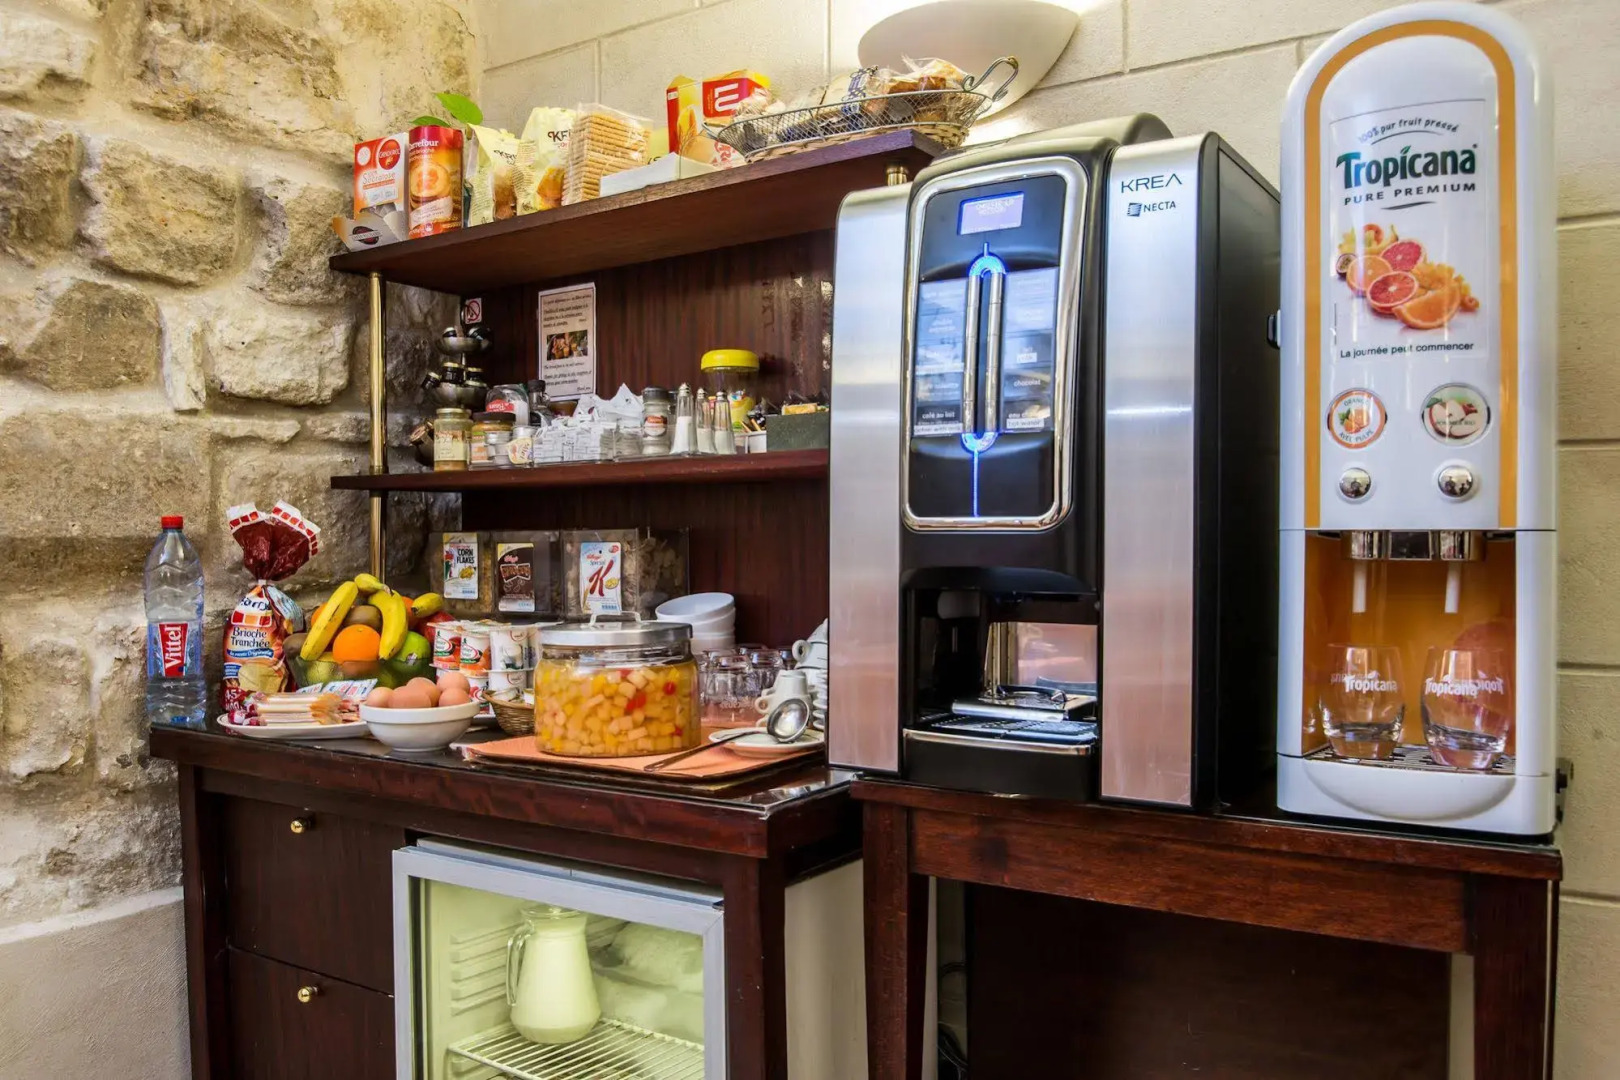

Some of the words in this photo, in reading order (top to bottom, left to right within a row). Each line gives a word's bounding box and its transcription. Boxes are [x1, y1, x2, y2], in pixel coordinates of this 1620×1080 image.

[1380, 122, 1396, 134] pur
[1398, 117, 1422, 127] fruit
[409, 138, 439, 149] arrefour
[1335, 146, 1476, 189] Tropicana
[1121, 173, 1182, 193] KREA
[1344, 191, 1384, 205] PURE
[1394, 183, 1476, 198] PREMIUM
[1143, 201, 1176, 212] NECTA
[1340, 350, 1351, 358] La
[1353, 346, 1388, 358] journée
[1416, 343, 1474, 352] commencer
[456, 556, 475, 564] FLAKES
[457, 548, 474, 557] CORN
[232, 626, 267, 638] Brioche
[164, 625, 182, 669] Vittel
[231, 636, 270, 648] Tranchée
[1344, 674, 1397, 693] Tropicana
[1425, 676, 1478, 698] Tropicana
